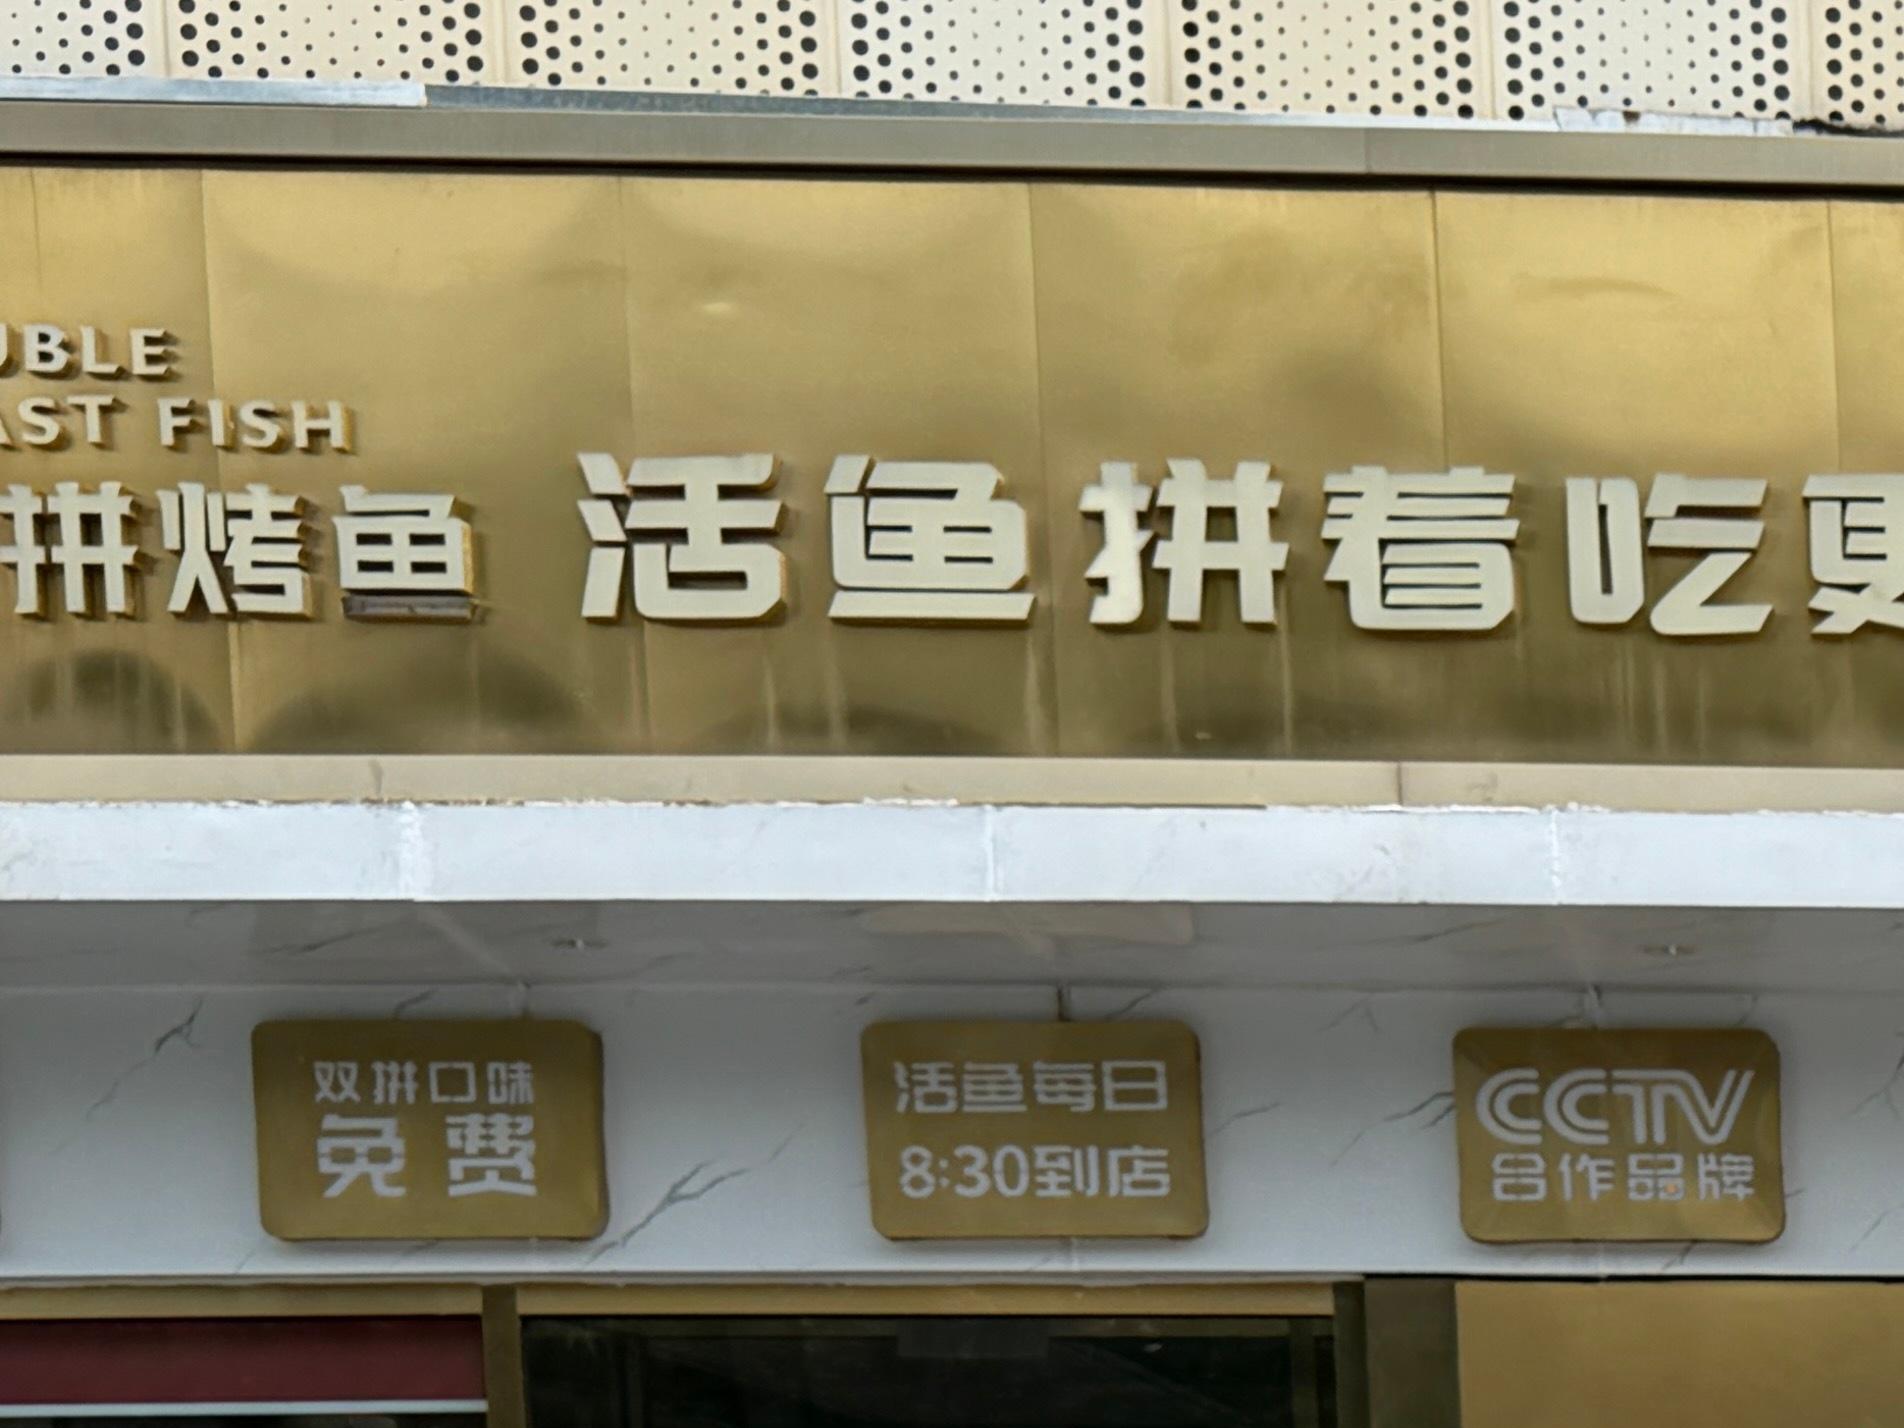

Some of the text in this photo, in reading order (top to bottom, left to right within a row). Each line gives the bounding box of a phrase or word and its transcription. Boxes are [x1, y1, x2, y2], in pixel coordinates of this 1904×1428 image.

[156, 397, 349, 452] FISH
[0, 481, 473, 618] 拼烤鱼
[313, 1060, 536, 1105] 双拼口味
[894, 1060, 1169, 1113] 活鱼每日
[1475, 1067, 1756, 1145] CCTV
[316, 1112, 538, 1198] 免费
[899, 1143, 1171, 1198] 8:30到店
[1490, 1152, 1755, 1202] 合作品牌
